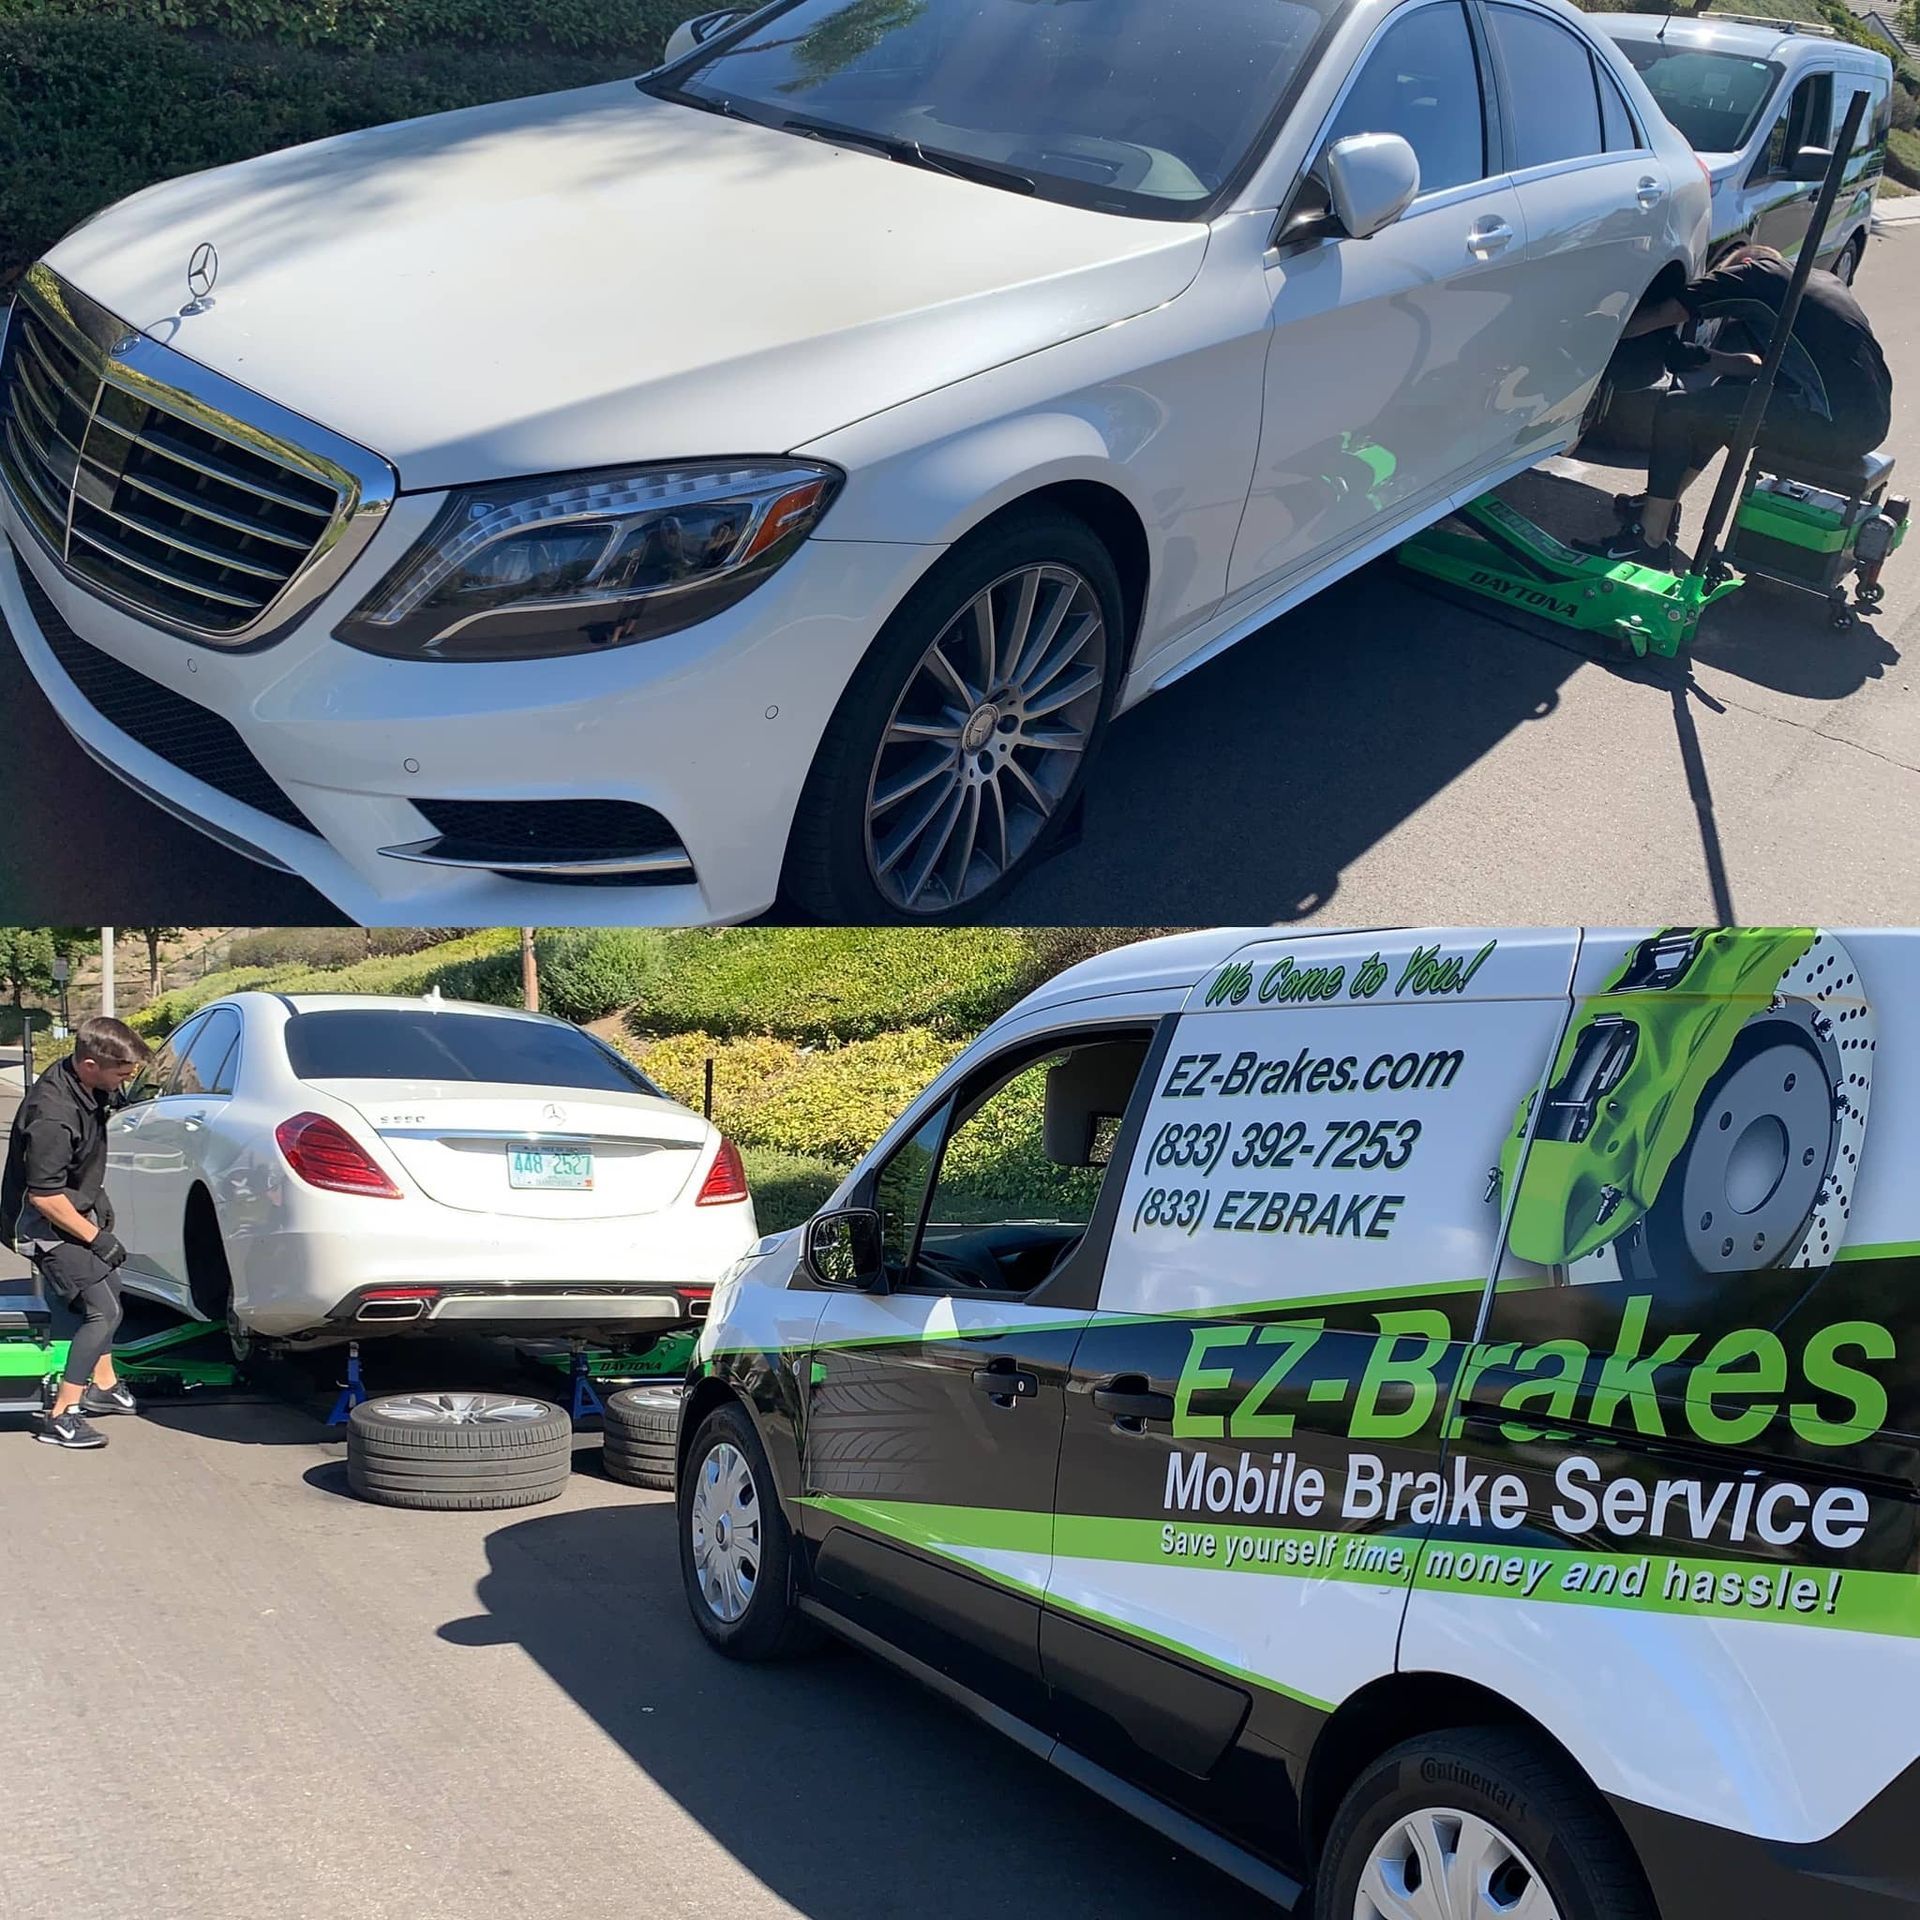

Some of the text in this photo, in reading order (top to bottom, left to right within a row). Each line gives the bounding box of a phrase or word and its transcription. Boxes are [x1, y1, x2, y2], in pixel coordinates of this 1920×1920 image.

[1469, 571, 1579, 618] DAYTONA
[1205, 939, 1497, 1007] We Come to You!
[1161, 1047, 1466, 1098] EZ-Brakes.com
[514, 1152, 591, 1175] 448 2527
[1144, 1119, 1423, 1177] (833) 392-7253
[1132, 1187, 1406, 1240] (833) EZBRAKE
[1172, 1294, 1897, 1446] EZ-Brakes
[1163, 1452, 1871, 1549] Mobile Brake Service
[1160, 1523, 1844, 1614] Save yourself time, money and hassle!
[1420, 1757, 1516, 1812] Continental
